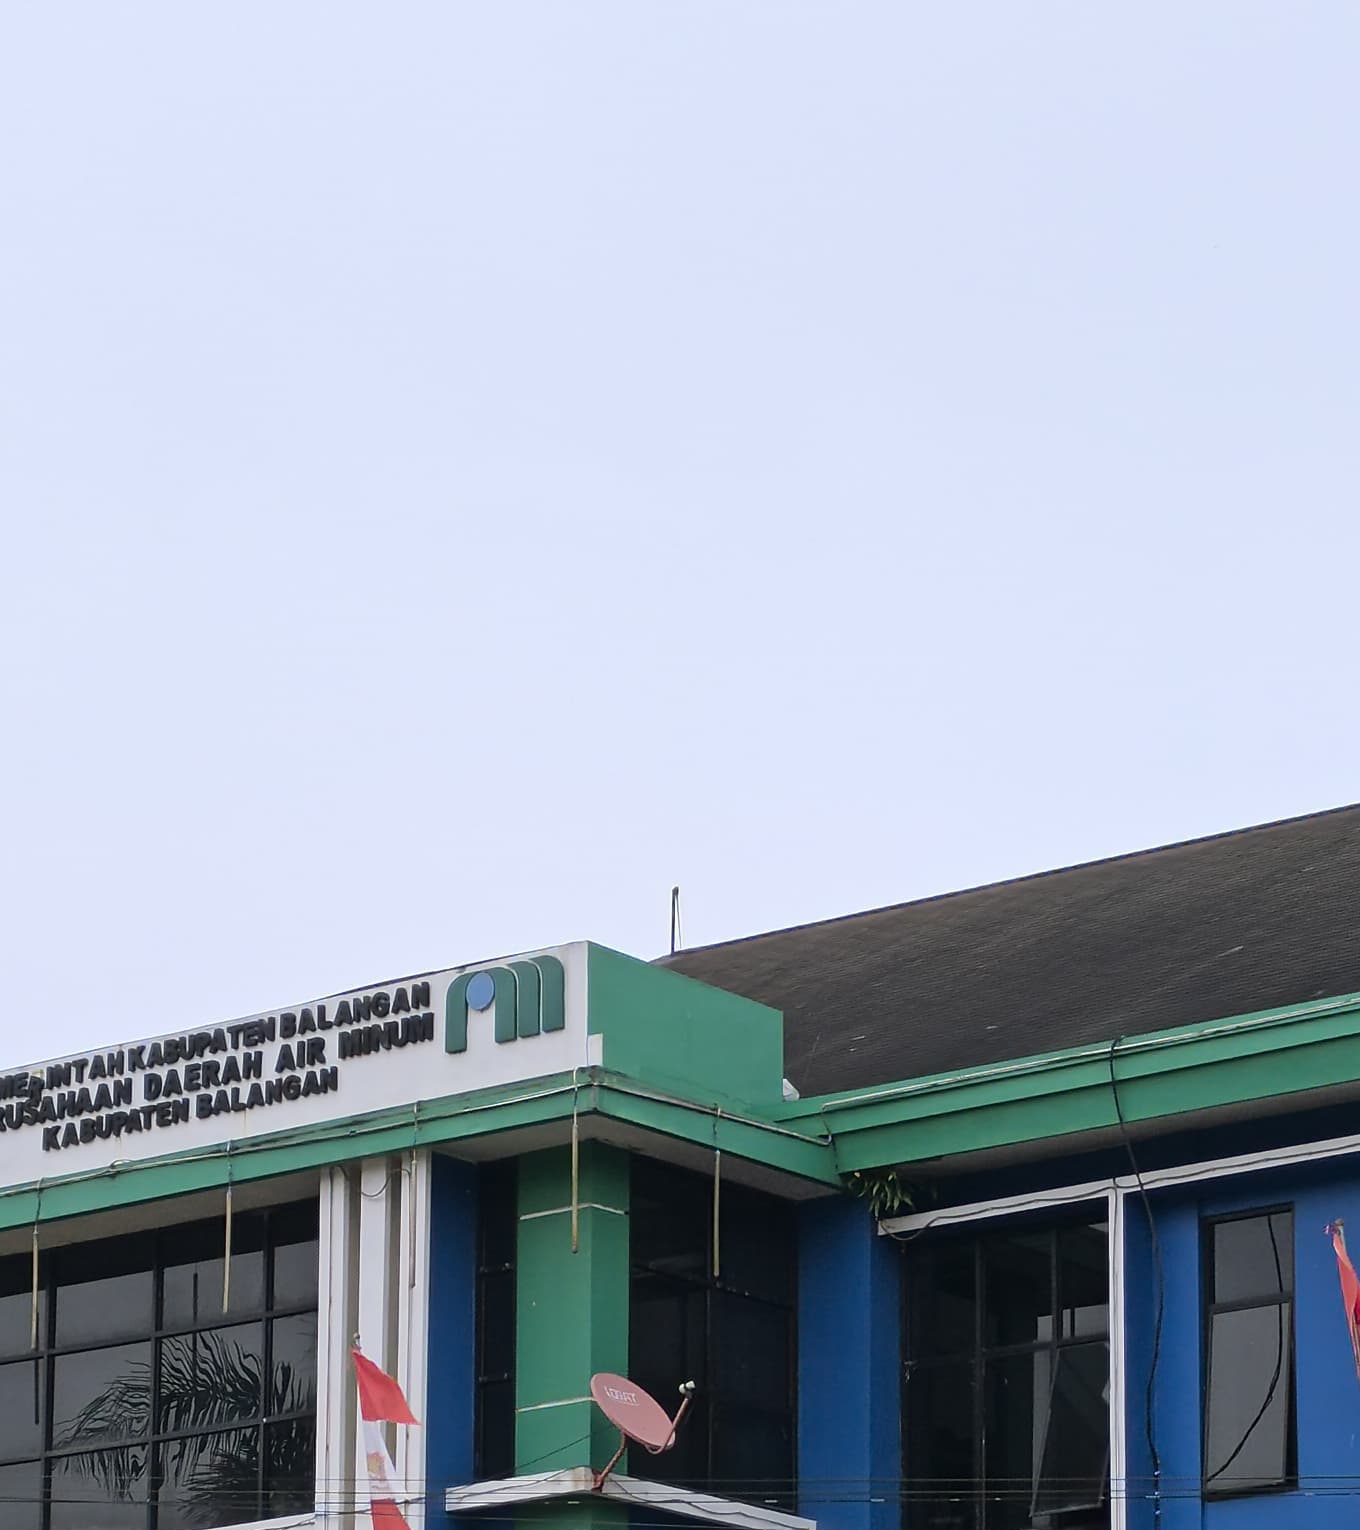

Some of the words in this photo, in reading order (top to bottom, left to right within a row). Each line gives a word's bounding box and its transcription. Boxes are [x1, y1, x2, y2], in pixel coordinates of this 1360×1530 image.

[128, 1017, 276, 1072] KABUPATEN
[280, 981, 430, 1038] BALANGAN
[143, 1051, 263, 1101] DAERAH
[275, 1037, 326, 1073] AIR
[338, 1012, 434, 1059] MINUM
[42, 1098, 189, 1151] KABUPATEN
[196, 1066, 338, 1118] BALANGAN
